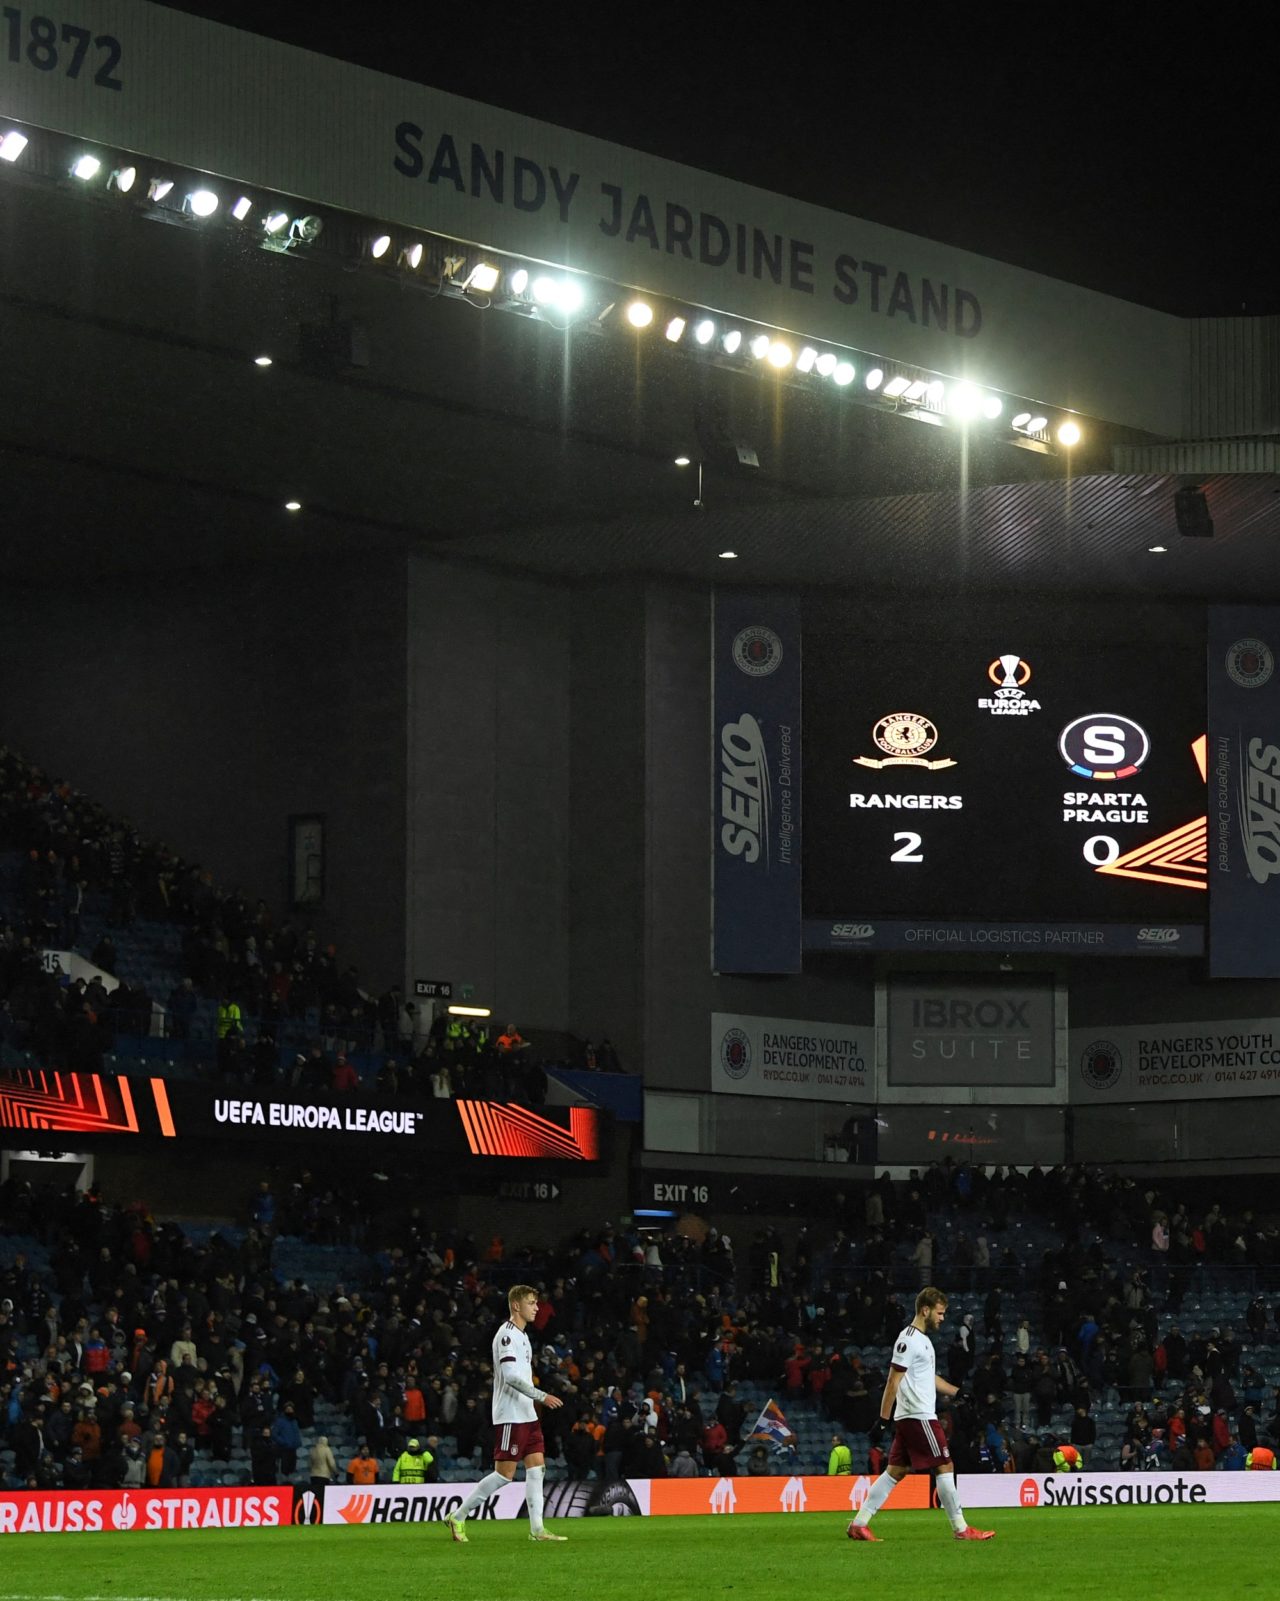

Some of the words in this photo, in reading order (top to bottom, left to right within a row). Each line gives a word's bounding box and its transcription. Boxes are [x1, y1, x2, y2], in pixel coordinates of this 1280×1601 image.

[3, 7, 123, 91] 1872
[394, 121, 579, 223] SANDY
[599, 184, 814, 295] JARDINE
[833, 254, 982, 339] STAND
[978, 698, 1041, 710] EUROPA
[880, 715, 931, 730] RANGERS
[778, 725, 793, 787] Delivered
[877, 737, 916, 756] FOOTBALL
[916, 738, 934, 753] CLUB
[1216, 736, 1231, 809] Intelligence
[721, 712, 764, 864] SEKO
[850, 793, 962, 810] RANGERS
[1063, 792, 1148, 807] SPARTA
[1063, 809, 1149, 823] PRAGUE
[777, 790, 794, 864] Intelligence
[890, 832, 923, 863] 2
[1083, 835, 1120, 866] 0
[1218, 813, 1231, 873] Delivered
[830, 923, 876, 939] SEKO
[904, 929, 967, 942] OFFICIAL
[970, 930, 1041, 943] LOGISTICS
[1044, 931, 1105, 944] PARTNER
[1136, 928, 1181, 942] SEKO
[416, 983, 436, 995] EXIT
[913, 999, 1031, 1029] IBROX
[763, 1033, 817, 1051] RANGERS
[819, 1039, 858, 1055] YOUTH
[912, 1039, 1031, 1060] SUITE
[1139, 1037, 1213, 1055] RANGERS
[1217, 1034, 1273, 1051] YOUTH
[763, 1050, 846, 1071] DEVELOPMENT
[848, 1057, 867, 1072] CO.
[1139, 1051, 1256, 1071] DEVELOPMENT
[763, 1070, 810, 1083] RYDC.CO.UK
[1139, 1072, 1203, 1085] RYDC.CO.UK
[1215, 1071, 1237, 1082] 0141
[1239, 1070, 1257, 1081] 427
[215, 1099, 266, 1125] UEFA
[269, 1103, 342, 1130] EUROPA
[345, 1108, 415, 1135] LEAGUE
[533, 1183, 548, 1199] 16
[653, 1184, 688, 1202] EXIT
[692, 1186, 709, 1203] 16
[145, 1496, 280, 1530] STRAUSS
